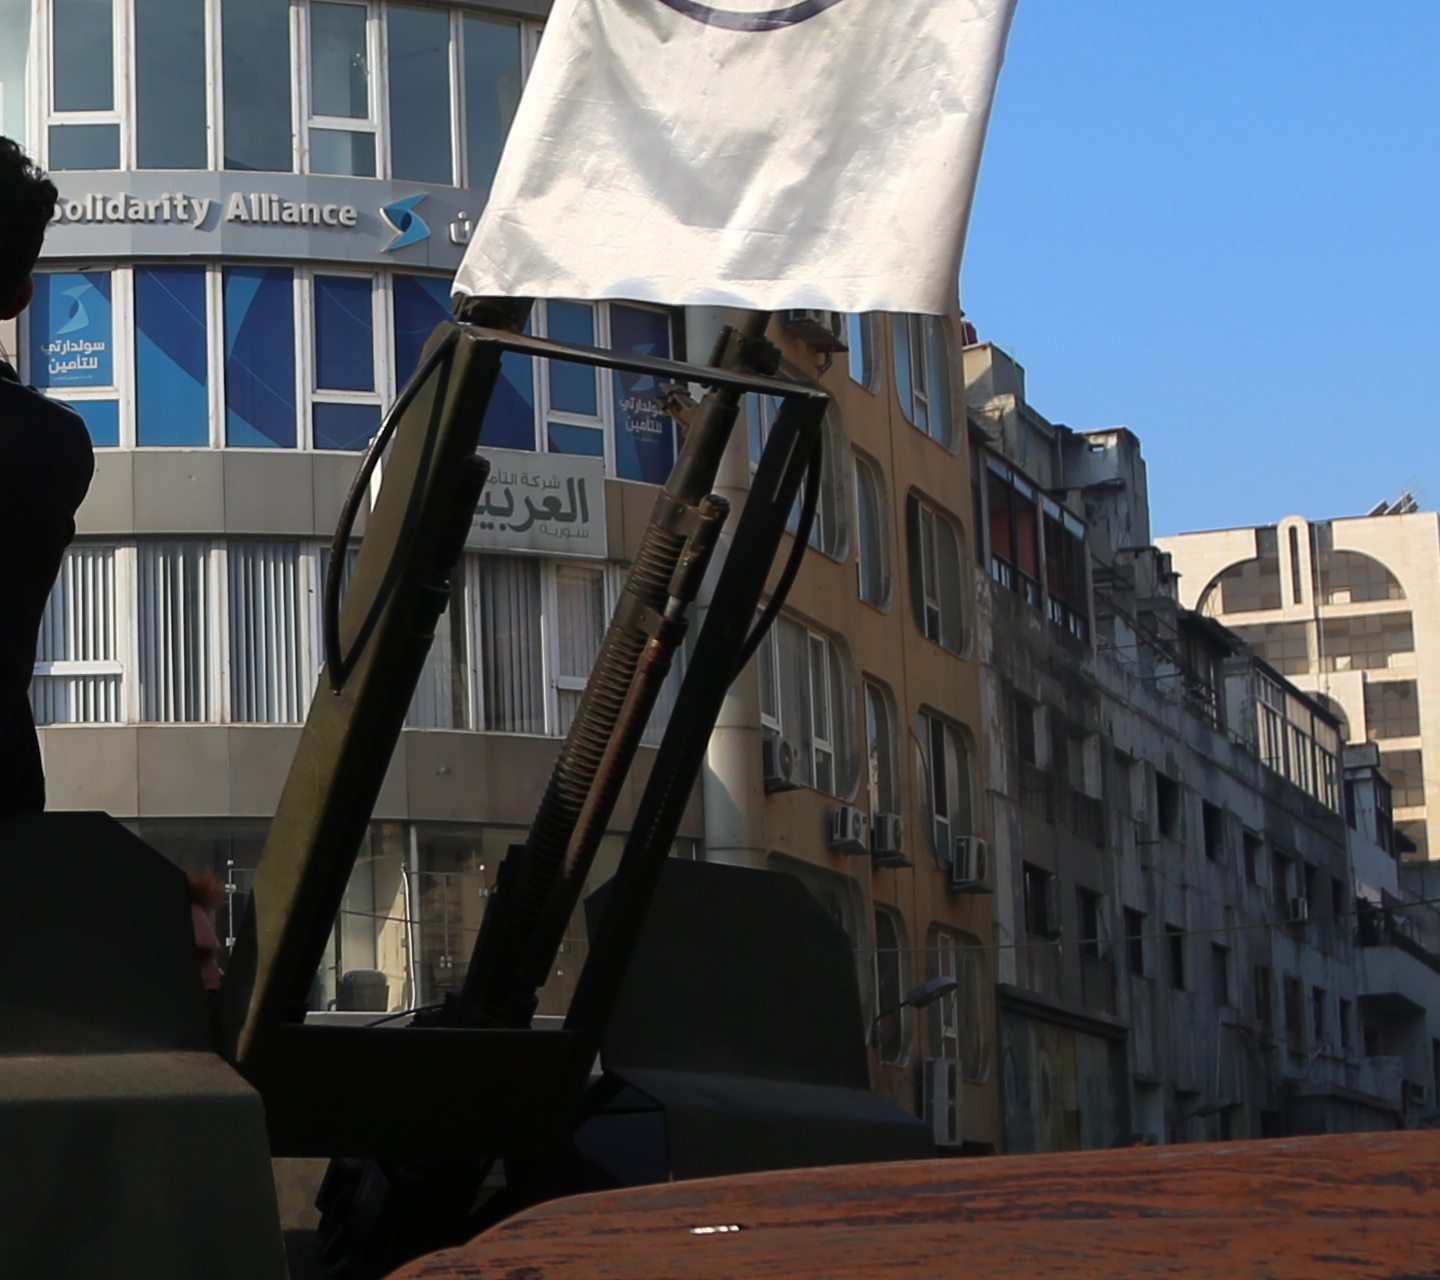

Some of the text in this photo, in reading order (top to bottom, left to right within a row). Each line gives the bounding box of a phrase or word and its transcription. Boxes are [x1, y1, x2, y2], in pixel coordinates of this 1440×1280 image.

[226, 191, 358, 227] Alliance
[40, 338, 106, 355] سولدارتي
[48, 354, 98, 375] للتأمين
[486, 468, 561, 491] شركة التأم
[474, 476, 590, 533] العربي
[539, 521, 590, 539] سورية
